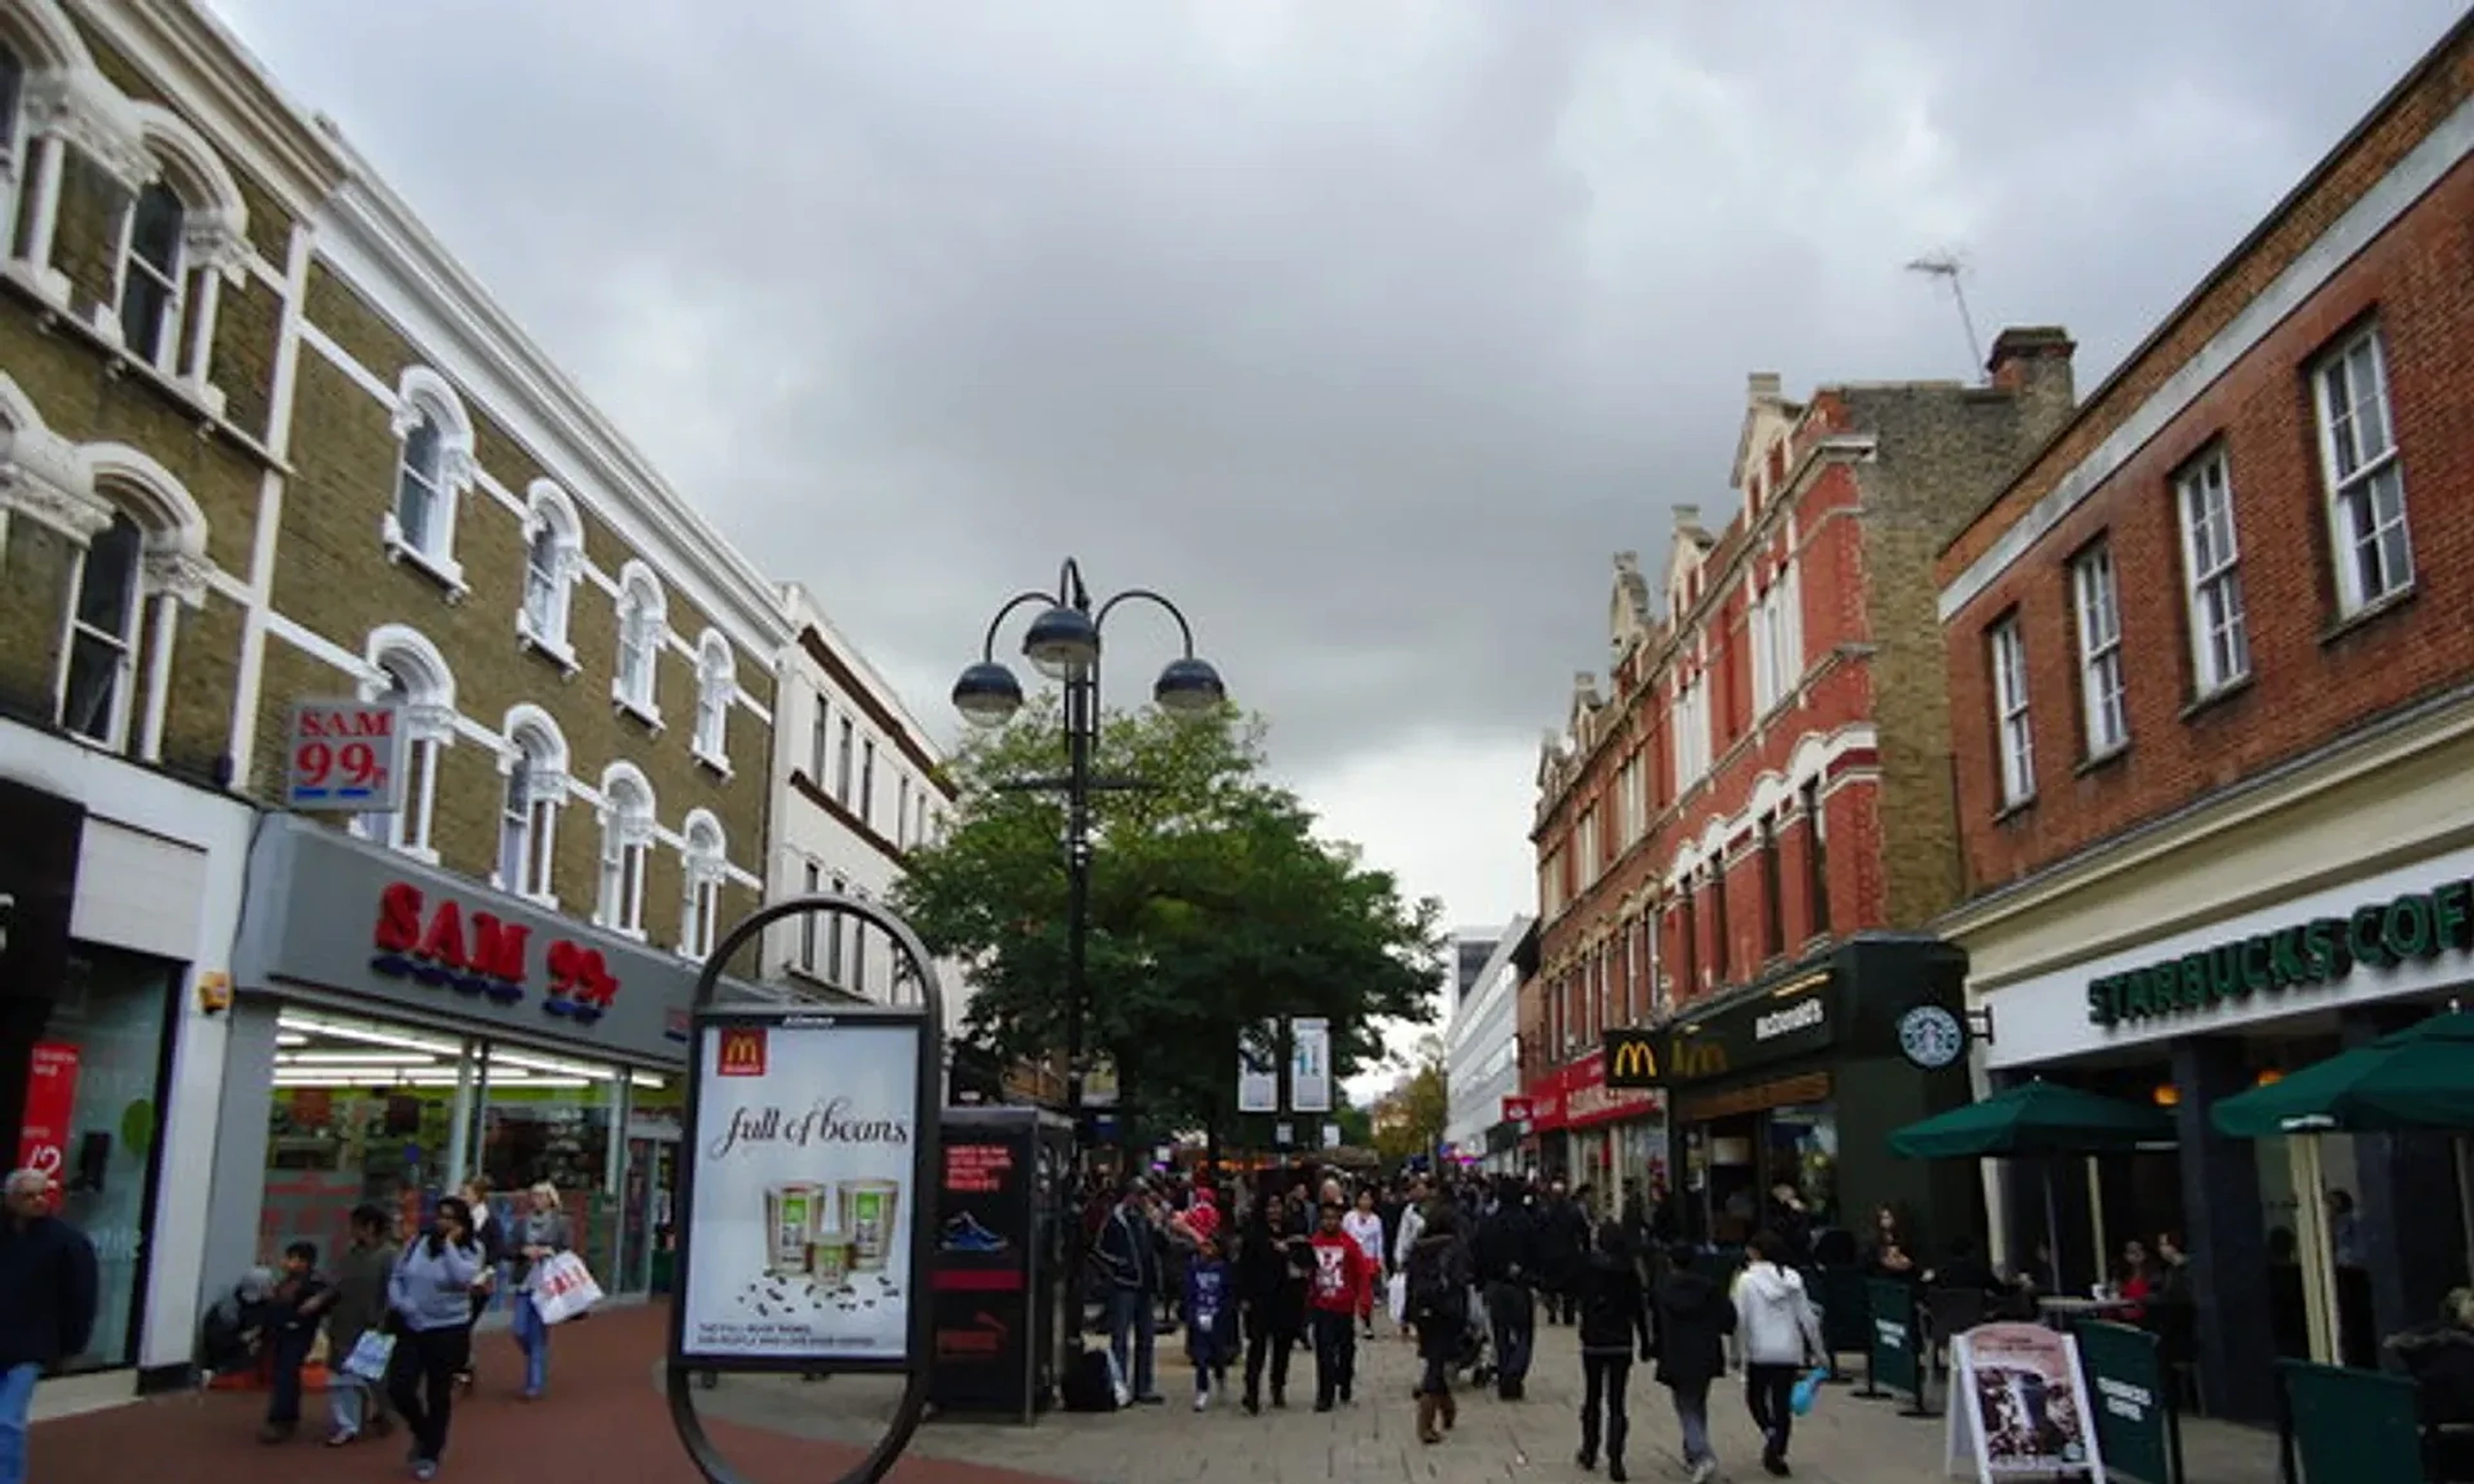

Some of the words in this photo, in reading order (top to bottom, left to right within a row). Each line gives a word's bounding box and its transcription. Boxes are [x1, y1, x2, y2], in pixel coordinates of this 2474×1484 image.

[299, 709, 394, 737] SAM
[375, 882, 533, 982] SAM
[2089, 918, 2340, 1024] STARBUCKS
[710, 1106, 781, 1159] full
[784, 1099, 821, 1146] of
[820, 1096, 907, 1145] beans
